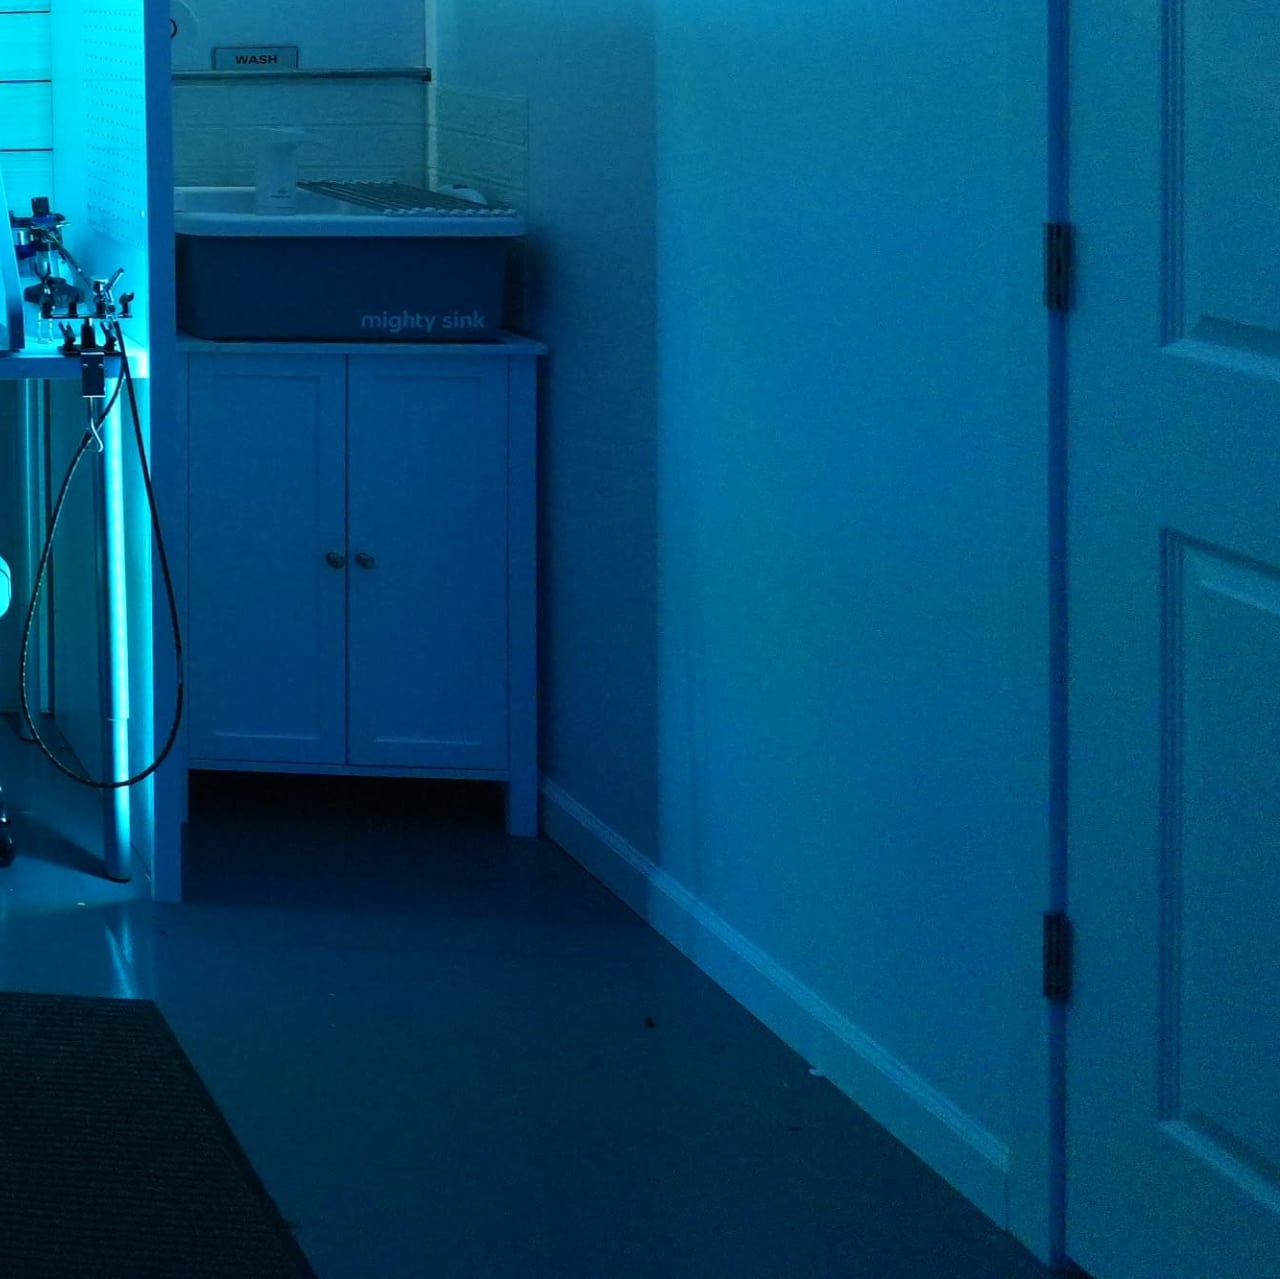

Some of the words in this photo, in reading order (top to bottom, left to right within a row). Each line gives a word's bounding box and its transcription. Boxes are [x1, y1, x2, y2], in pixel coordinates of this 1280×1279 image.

[235, 55, 278, 65] WASH
[361, 310, 436, 333] mighty
[442, 310, 487, 329] sink
